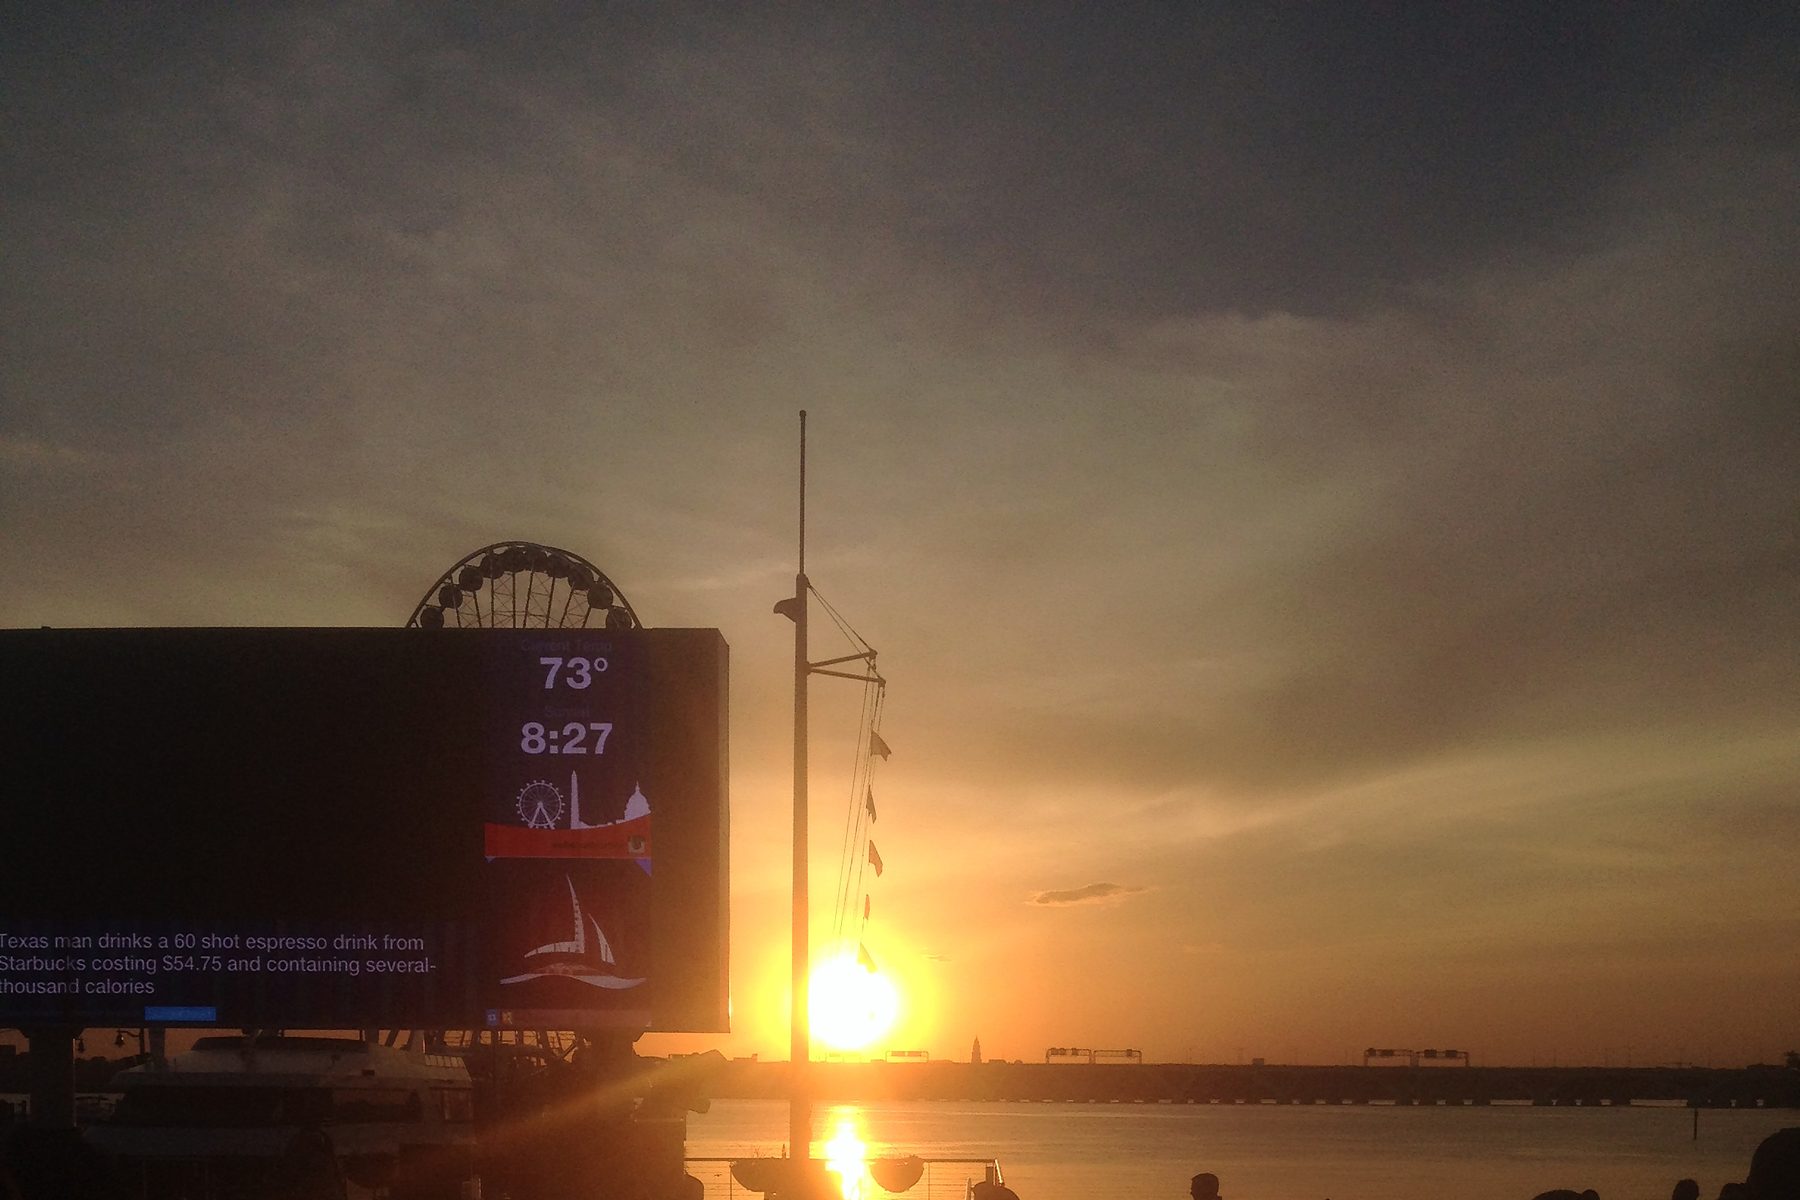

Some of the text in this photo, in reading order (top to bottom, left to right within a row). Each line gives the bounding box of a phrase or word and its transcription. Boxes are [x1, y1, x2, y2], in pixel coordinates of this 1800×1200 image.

[520, 721, 613, 755] 8:27
[0, 933, 424, 953] Texas man drinks a 60 shot espresso drink from
[0, 954, 437, 977] Starbucks costing $54.75 and containing several-
[0, 978, 156, 994] thousand calories
